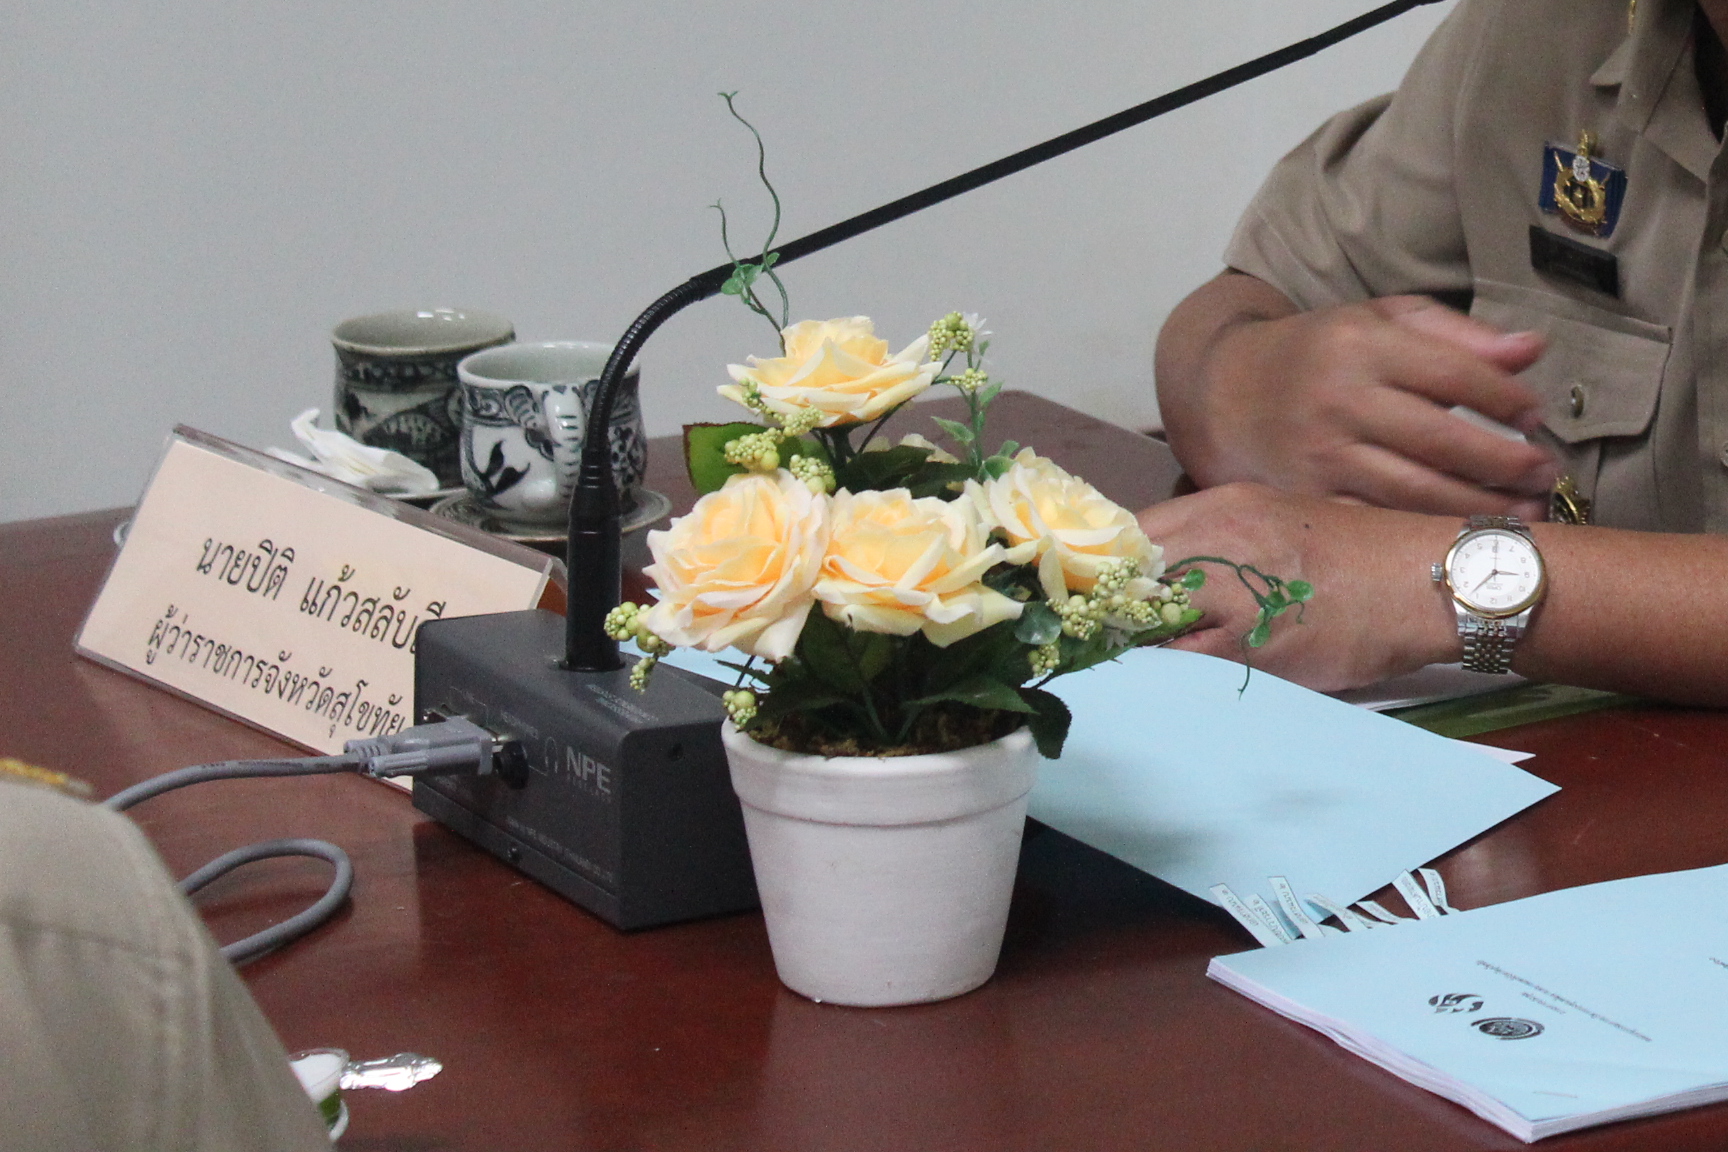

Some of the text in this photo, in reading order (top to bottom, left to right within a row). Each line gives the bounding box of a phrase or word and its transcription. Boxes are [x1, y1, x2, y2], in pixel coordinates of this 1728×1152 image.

[197, 538, 447, 654] นายปิติ แก้วสลับี
[566, 746, 612, 795] NPE
